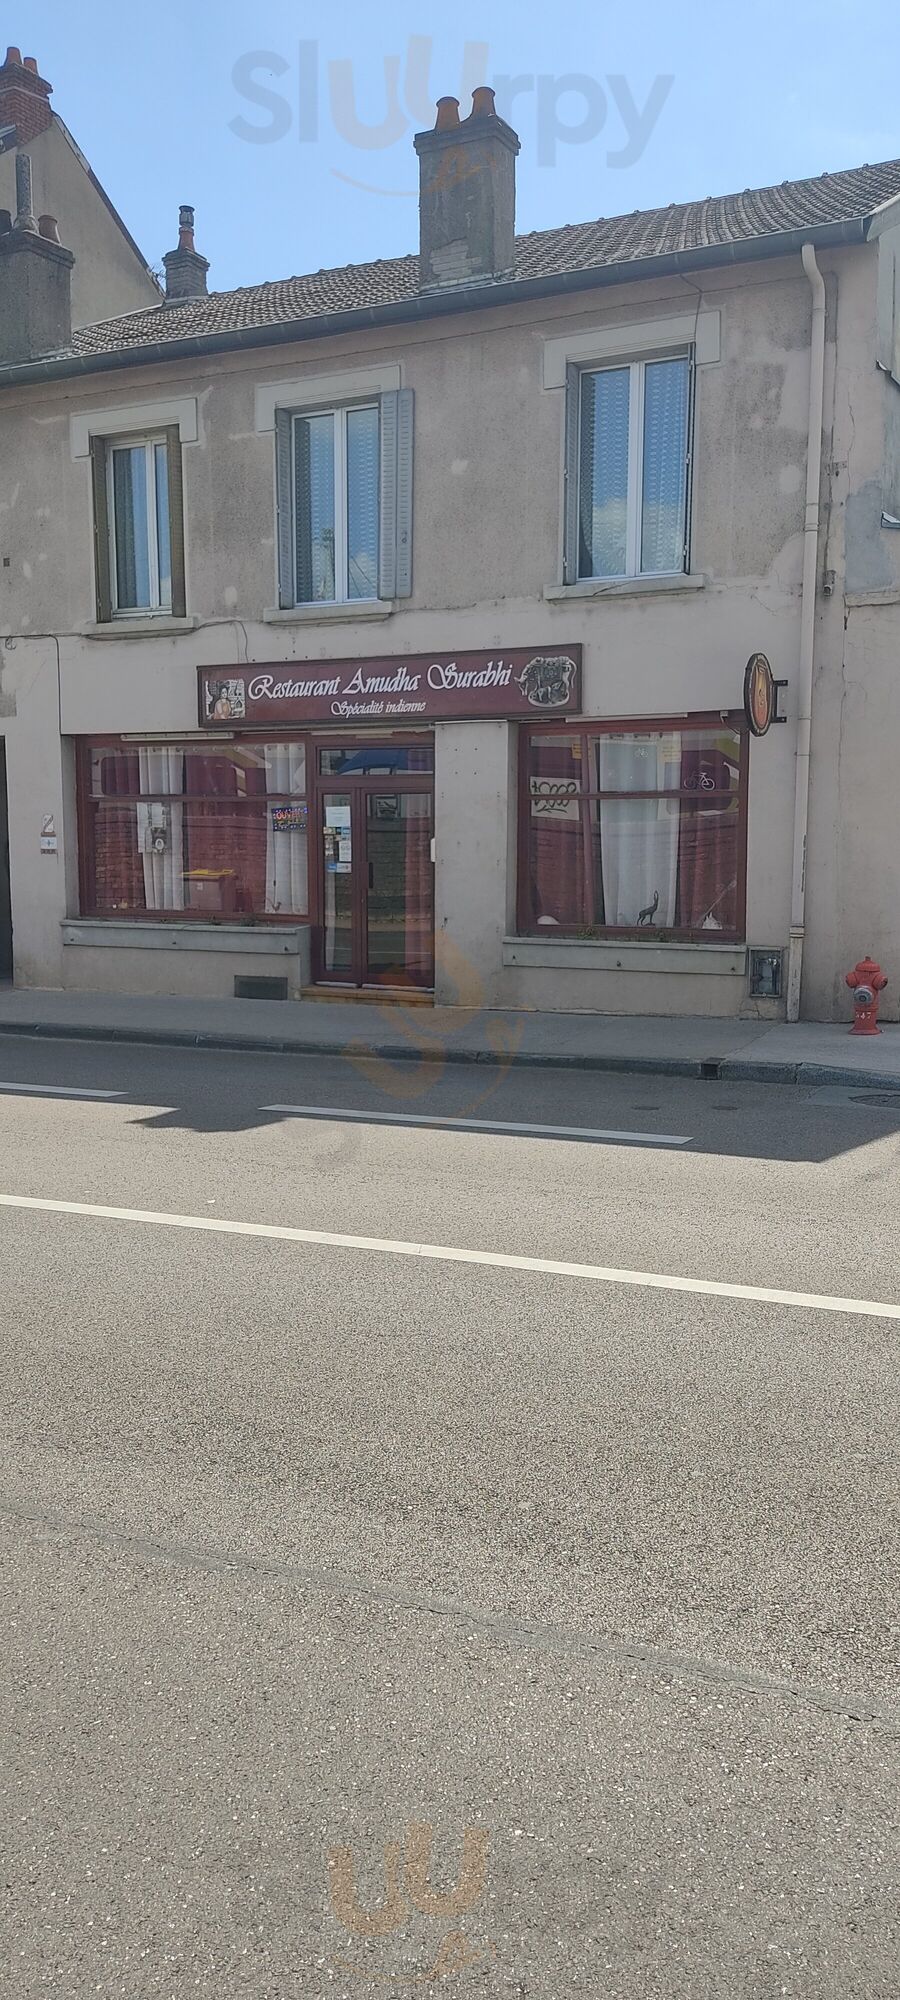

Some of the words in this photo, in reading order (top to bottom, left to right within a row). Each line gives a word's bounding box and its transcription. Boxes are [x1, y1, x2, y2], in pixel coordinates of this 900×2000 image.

[249, 675, 341, 699] Restaurant
[342, 667, 421, 694] Amudha
[427, 661, 513, 690] Surabhi
[331, 701, 383, 718] Spécialité
[385, 699, 427, 713] indienne
